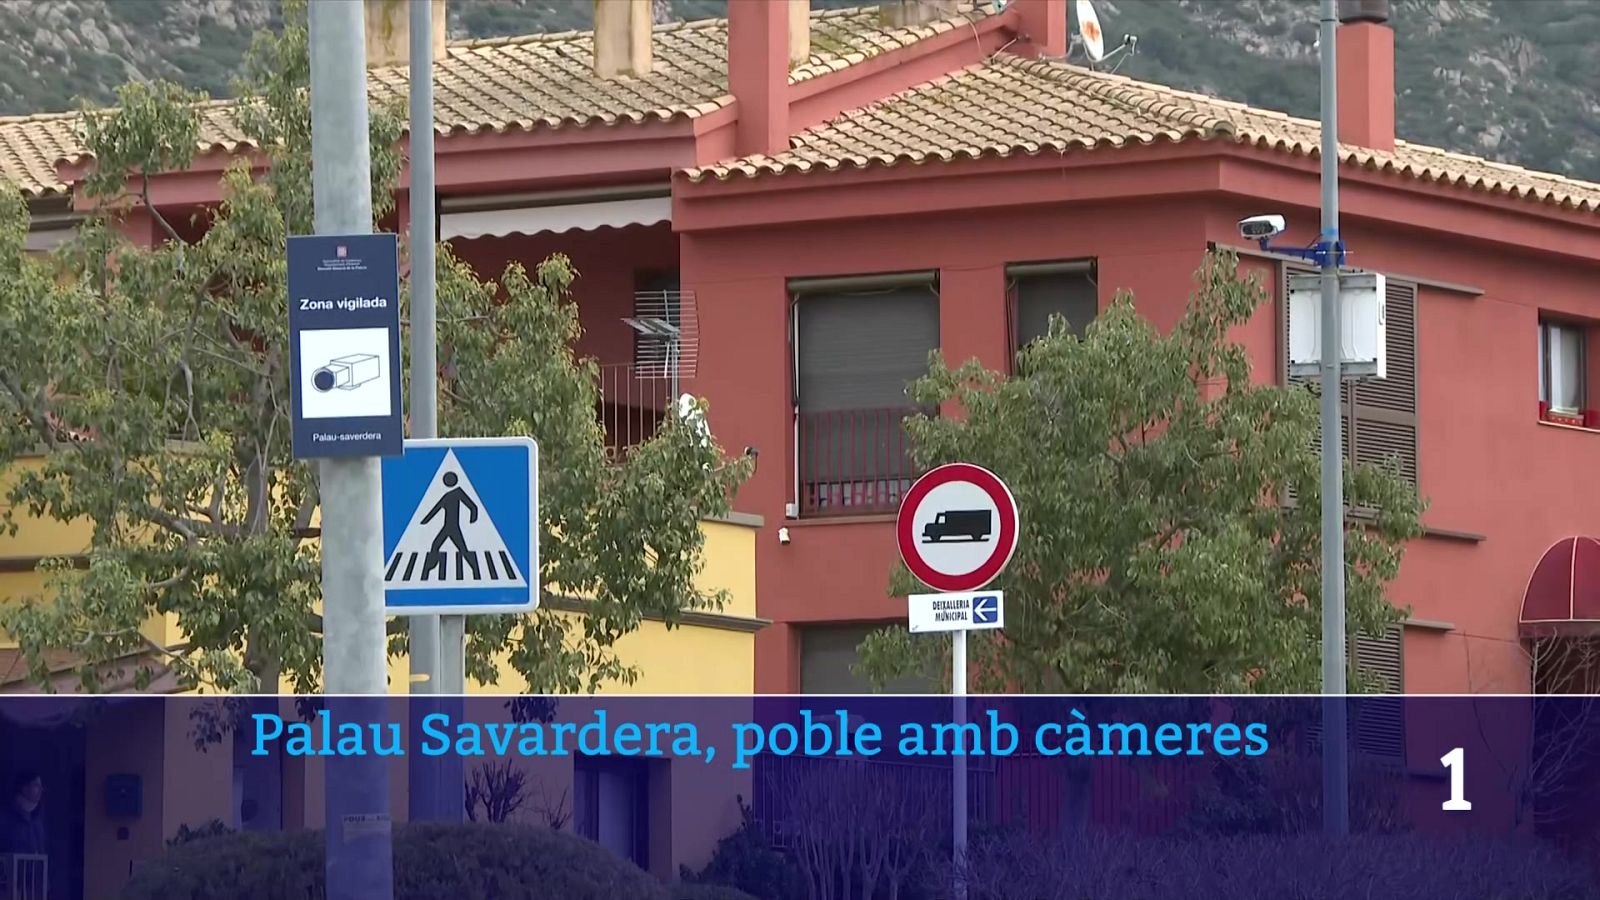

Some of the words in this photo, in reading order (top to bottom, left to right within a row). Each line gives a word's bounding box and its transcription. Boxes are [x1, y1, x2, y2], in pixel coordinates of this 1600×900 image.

[300, 298, 333, 310] Zona
[336, 296, 387, 311] vigilada
[932, 599, 970, 611] DEIXALLERIA
[934, 610, 968, 622] MUNICIPAL
